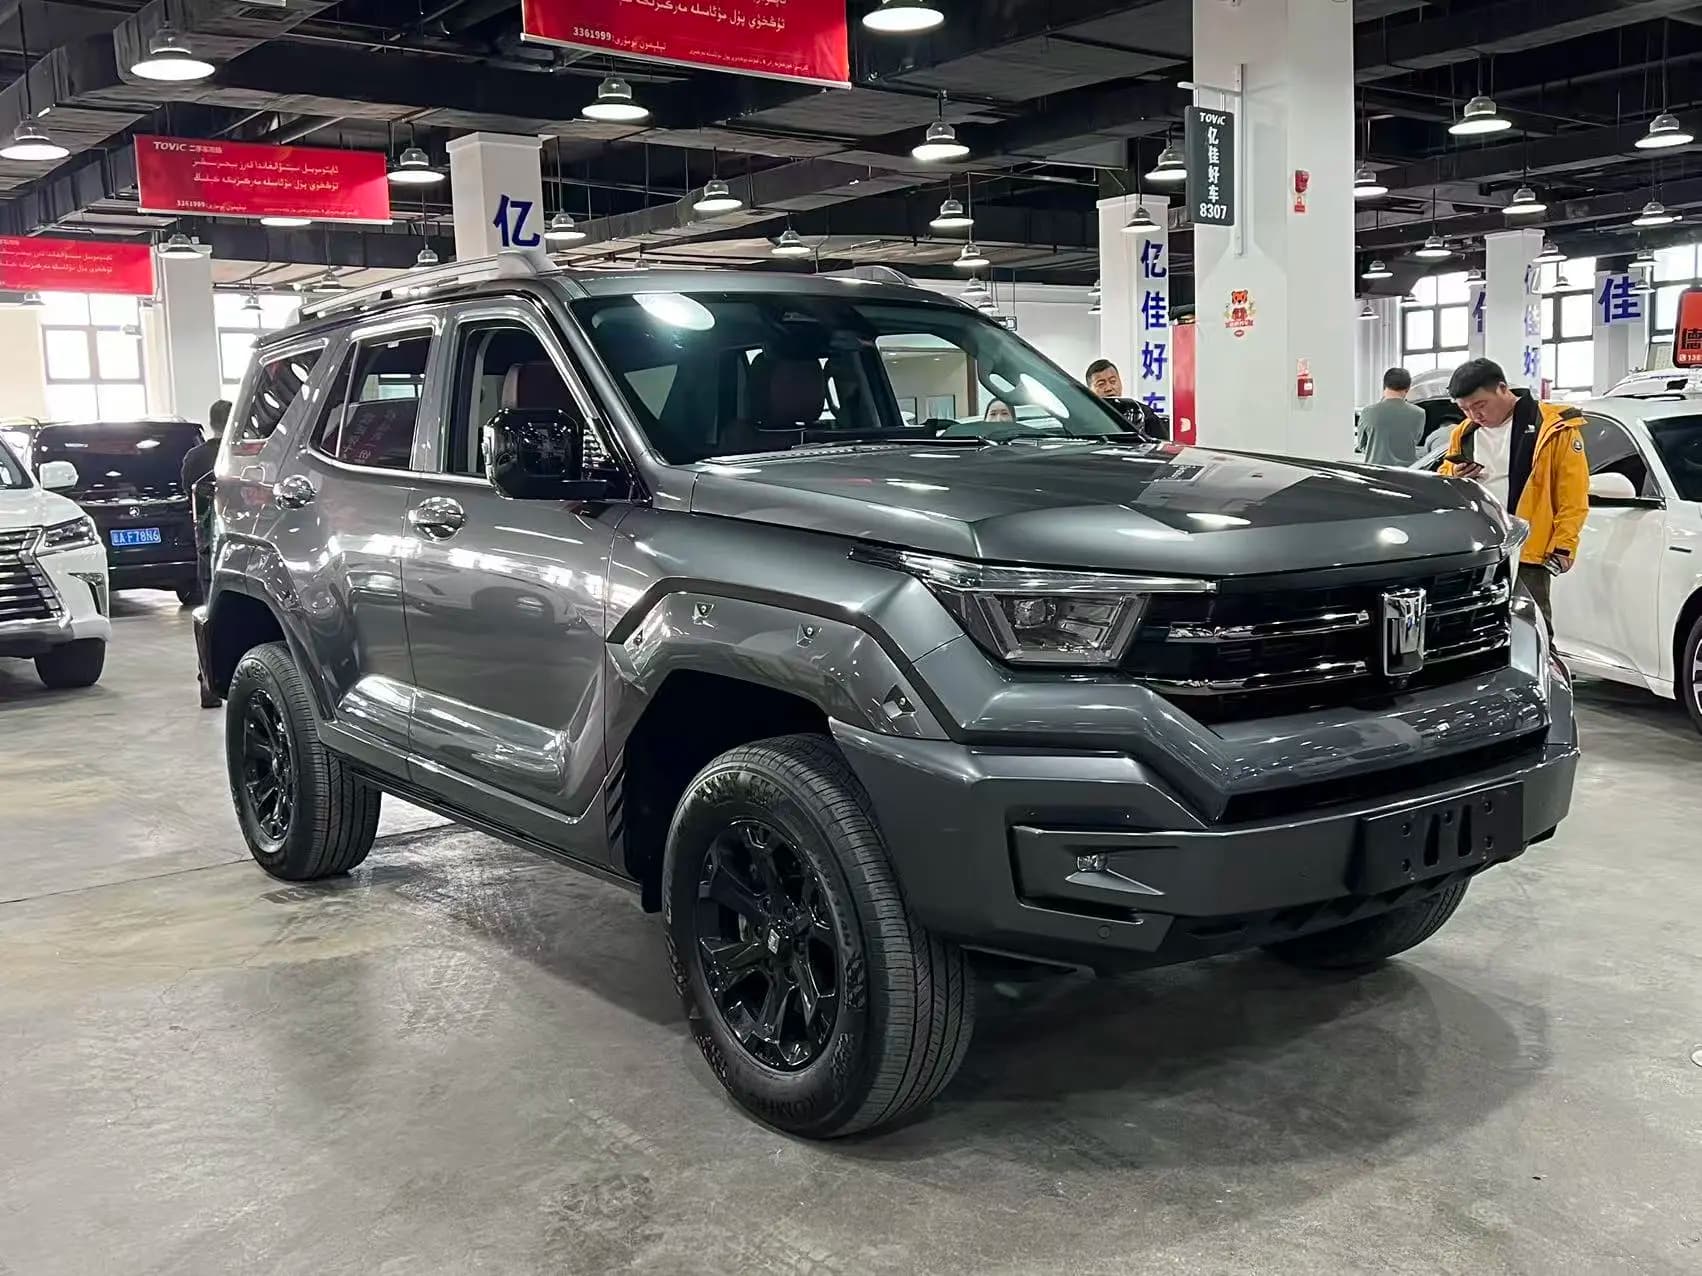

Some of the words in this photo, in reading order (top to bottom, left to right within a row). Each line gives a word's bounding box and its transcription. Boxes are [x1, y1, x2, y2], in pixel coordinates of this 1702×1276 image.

[573, 26, 612, 41] 3361999
[1207, 126, 1220, 203] 亿佳好车
[493, 194, 541, 247] 亿
[1199, 202, 1227, 220] 8307
[1598, 276, 1641, 323] 佳
